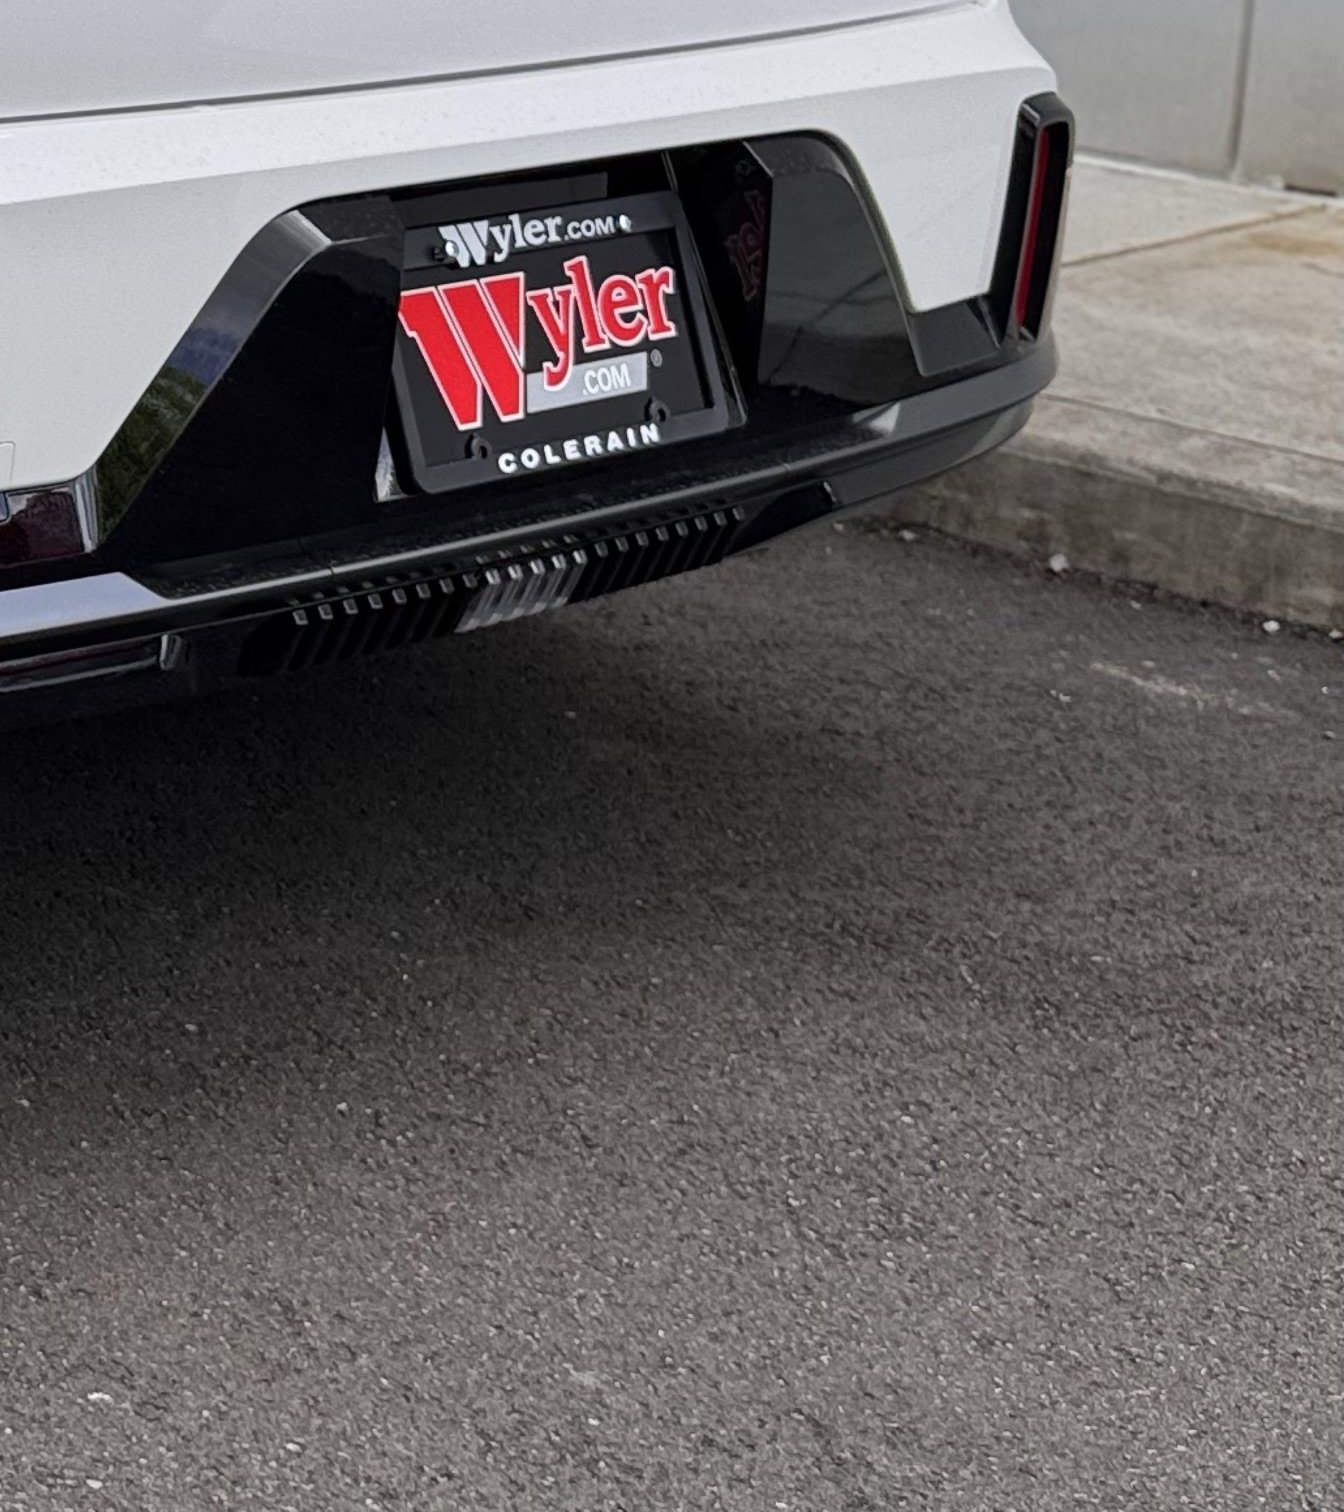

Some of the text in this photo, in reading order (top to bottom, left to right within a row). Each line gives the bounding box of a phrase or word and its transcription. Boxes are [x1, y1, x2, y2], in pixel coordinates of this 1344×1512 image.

[398, 255, 679, 432] Wyler
[581, 363, 632, 397] .COM
[497, 423, 660, 474] COLERAIN
